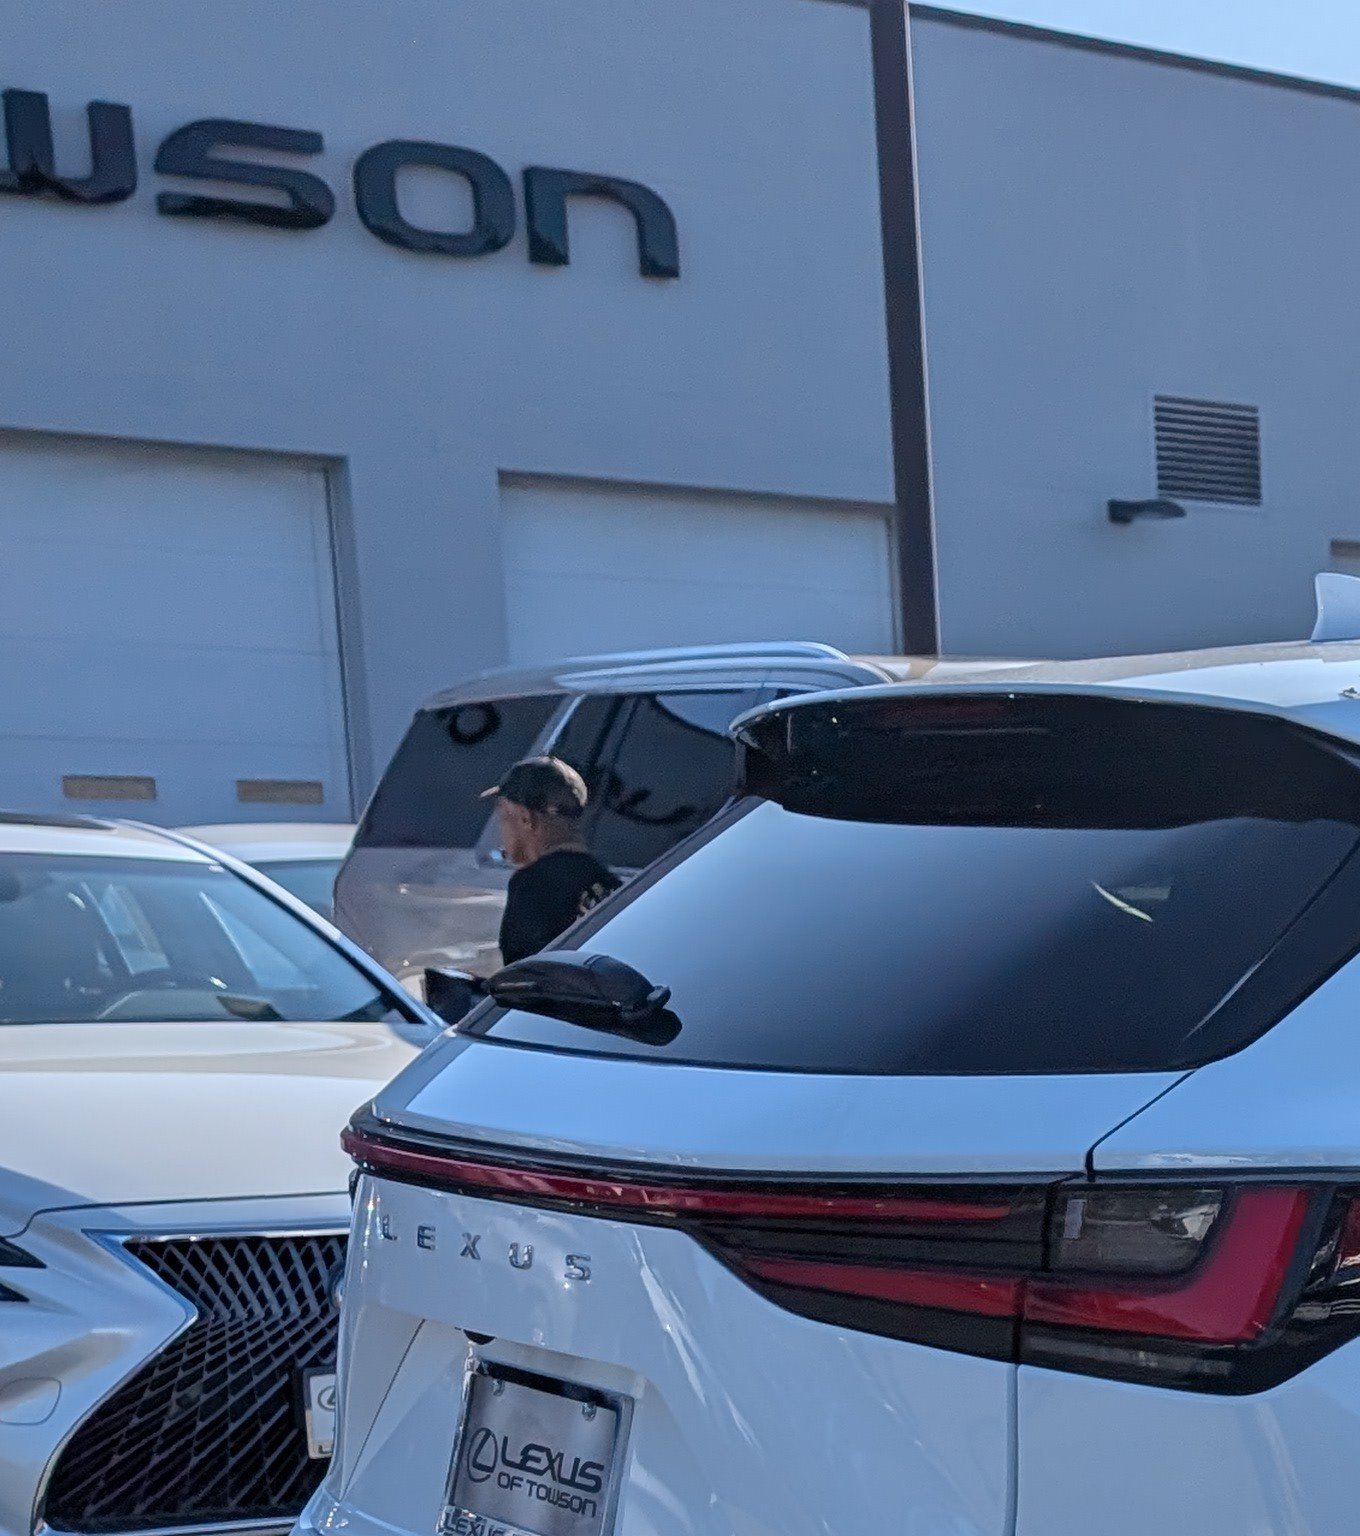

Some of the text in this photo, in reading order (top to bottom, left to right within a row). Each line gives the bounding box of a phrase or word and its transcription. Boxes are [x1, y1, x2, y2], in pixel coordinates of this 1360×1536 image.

[379, 1214, 592, 1282] LEXUS
[497, 1470, 522, 1491] OF
[501, 1435, 605, 1493] LEXUS
